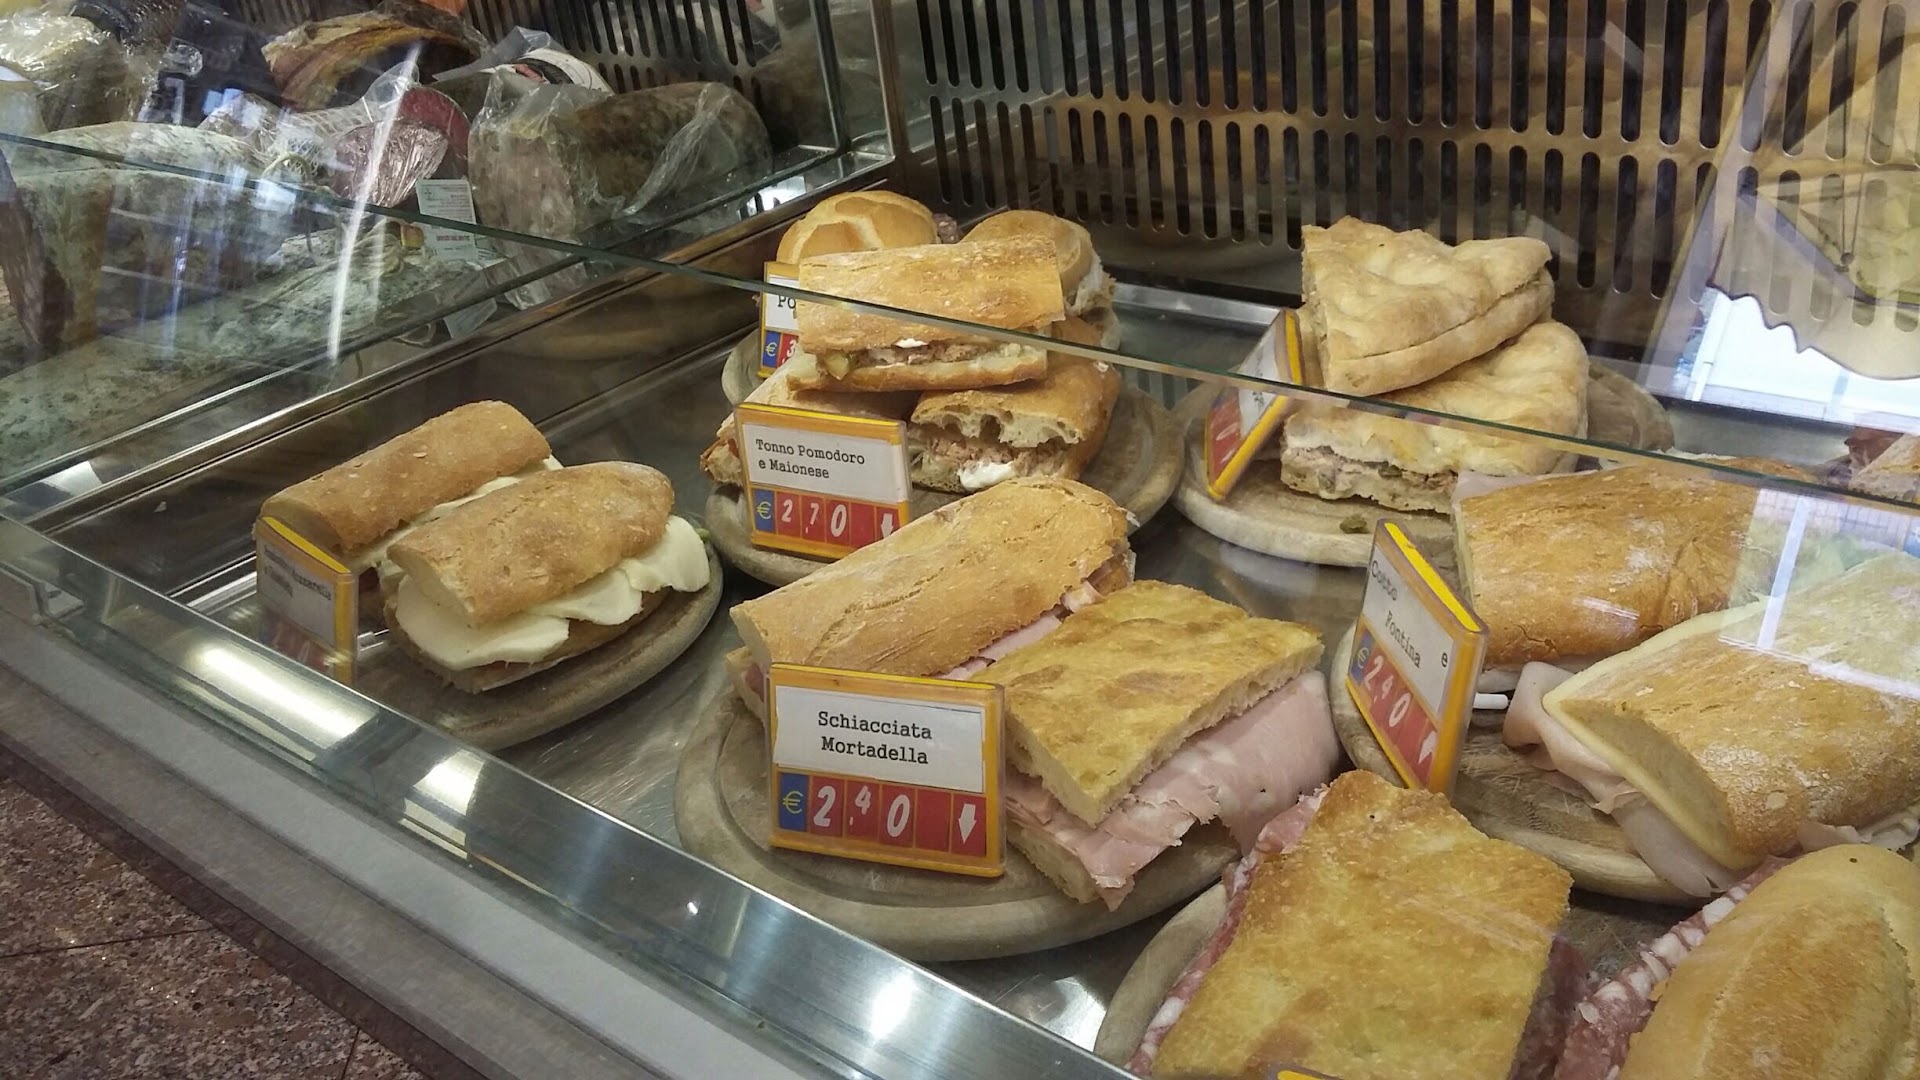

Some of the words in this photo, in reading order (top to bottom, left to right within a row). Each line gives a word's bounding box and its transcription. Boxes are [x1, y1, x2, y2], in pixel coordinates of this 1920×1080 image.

[756, 439, 795, 456] Tonno
[798, 444, 865, 465] Pomodoro
[758, 460, 766, 470] e
[770, 460, 830, 479] Maionese
[1385, 610, 1421, 669] Fontina
[818, 711, 933, 740] Schiacciata
[821, 736, 929, 765] Mortadella
